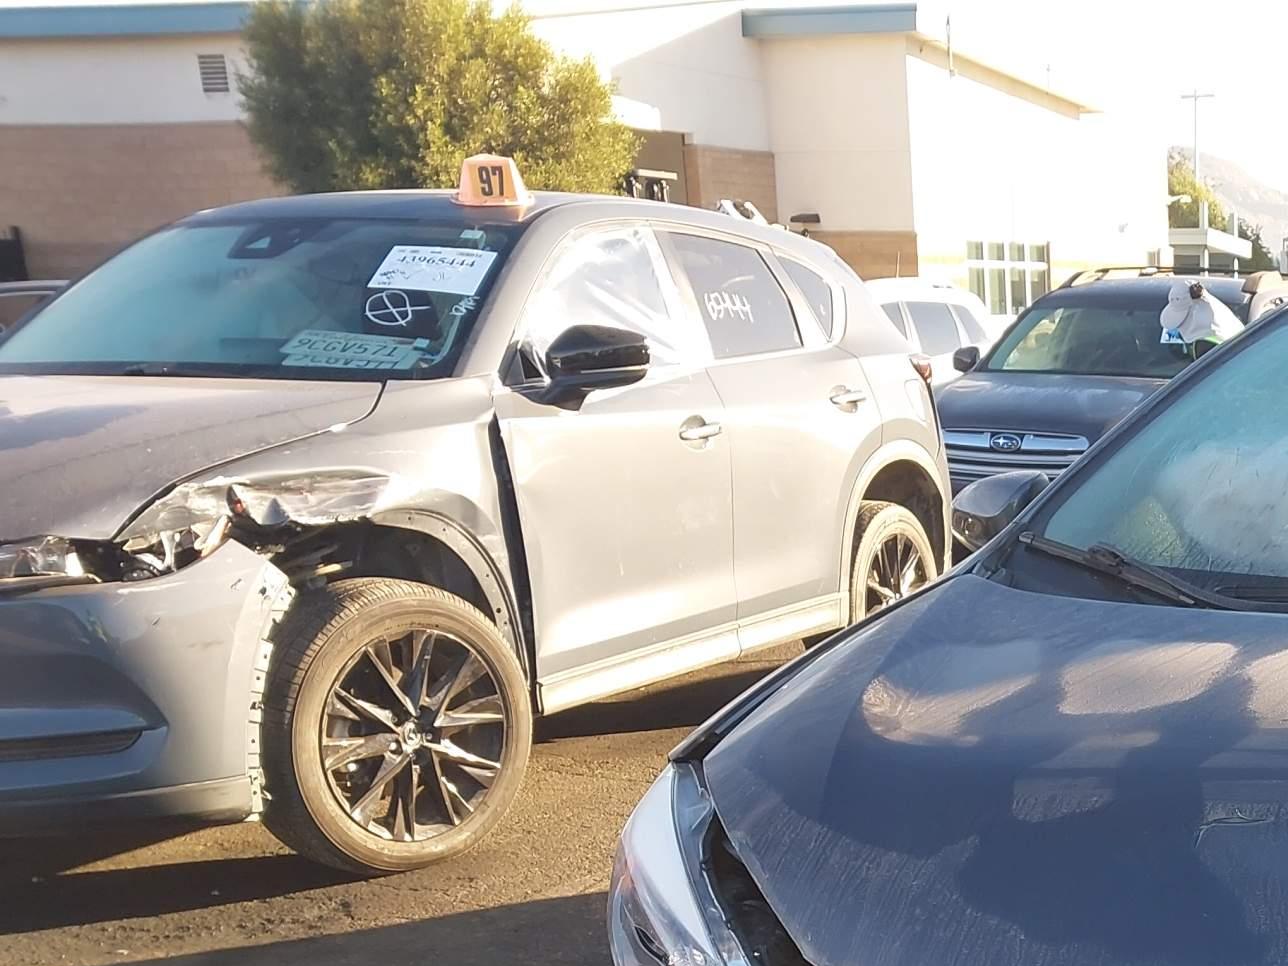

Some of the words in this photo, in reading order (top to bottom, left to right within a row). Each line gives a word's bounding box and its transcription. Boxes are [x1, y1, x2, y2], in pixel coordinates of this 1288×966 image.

[478, 165, 504, 197] 97
[397, 254, 477, 268] 43965444
[293, 338, 399, 358] 9CGV571
